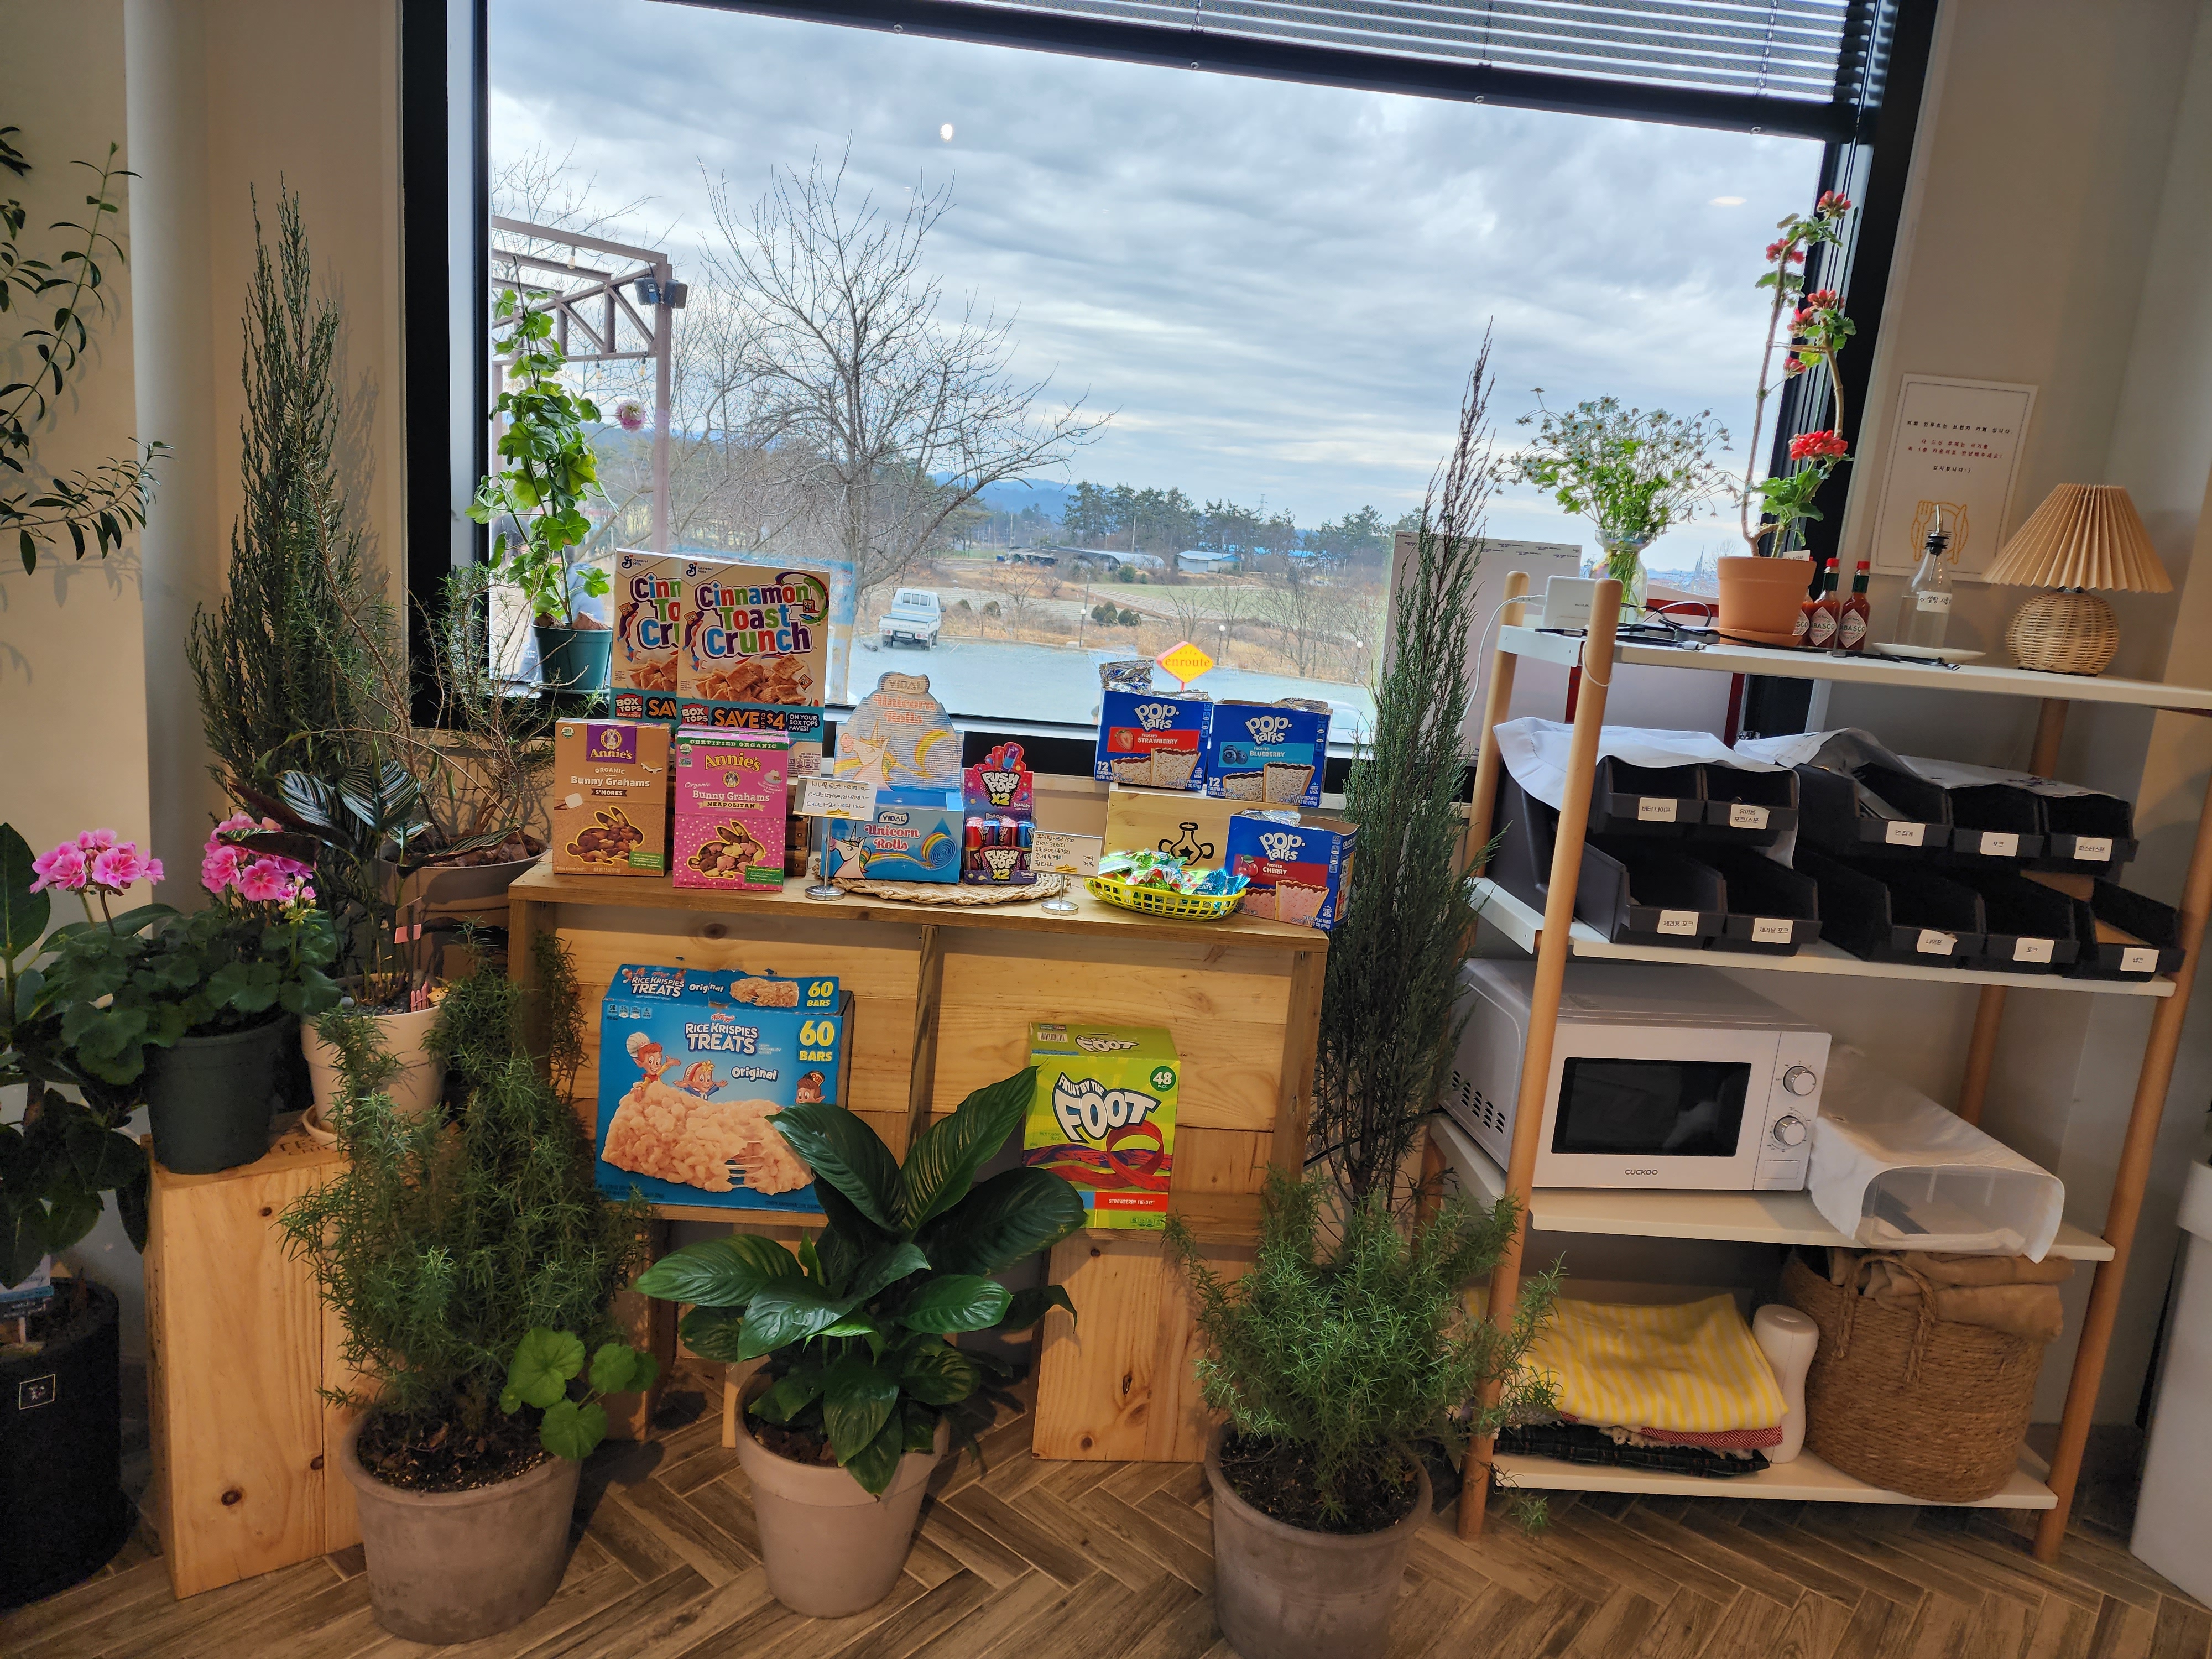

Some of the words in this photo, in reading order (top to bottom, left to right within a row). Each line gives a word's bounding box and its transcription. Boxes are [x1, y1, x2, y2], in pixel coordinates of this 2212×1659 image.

[700, 582, 809, 607] Cinnamon
[1927, 596, 1939, 604] 설탕
[719, 604, 790, 630] Toast
[641, 619, 679, 646] Cr
[707, 622, 810, 655] Crunch
[1165, 658, 1210, 667] enroute
[887, 679, 923, 690] VIDAL
[615, 698, 639, 707] BOX
[873, 693, 937, 712] Unicorn
[681, 708, 704, 717] BOX
[884, 711, 923, 725] Rolls
[714, 709, 760, 728] SAVE
[766, 713, 785, 730] $4
[1141, 718, 1173, 731] tarts
[1253, 731, 1285, 744] tarts
[590, 748, 633, 760] Annie's
[705, 752, 761, 772] Annie's
[1097, 761, 1109, 771] 12
[571, 775, 603, 787] Bunny
[606, 776, 650, 787] Grahams
[982, 772, 1020, 784] PUSH
[1208, 776, 1220, 787] 12
[684, 781, 711, 790] Organic
[988, 781, 1016, 792] POP
[692, 790, 724, 801] Bunny
[727, 792, 770, 801] Grahams
[990, 792, 1010, 805] X2
[864, 824, 921, 838] Unicorn
[874, 837, 909, 851] Rolls
[984, 850, 1019, 861] PUSH
[1266, 848, 1298, 861] tarts
[989, 859, 1016, 869] POP
[992, 868, 1010, 880] X2
[1262, 867, 1287, 875] CHERRY
[650, 977, 685, 987] KRISPIES
[632, 983, 681, 997] TREATS
[808, 981, 834, 998] 60
[711, 1013, 735, 1022] Kellogg's
[685, 1023, 709, 1034] RICE
[711, 1022, 758, 1039] KRISPIES
[800, 1021, 834, 1047] 60
[687, 1034, 755, 1054] TREATS
[1077, 1039, 1140, 1052] FOOT
[799, 1051, 832, 1062] BARS
[732, 1066, 778, 1081] Original
[811, 1073, 822, 1084] POP
[1152, 1072, 1172, 1085] 48
[1058, 1074, 1080, 1096] FRUIT
[1080, 1080, 1089, 1093] BY
[1091, 1081, 1104, 1097] THE
[1055, 1088, 1157, 1141] FOOT
